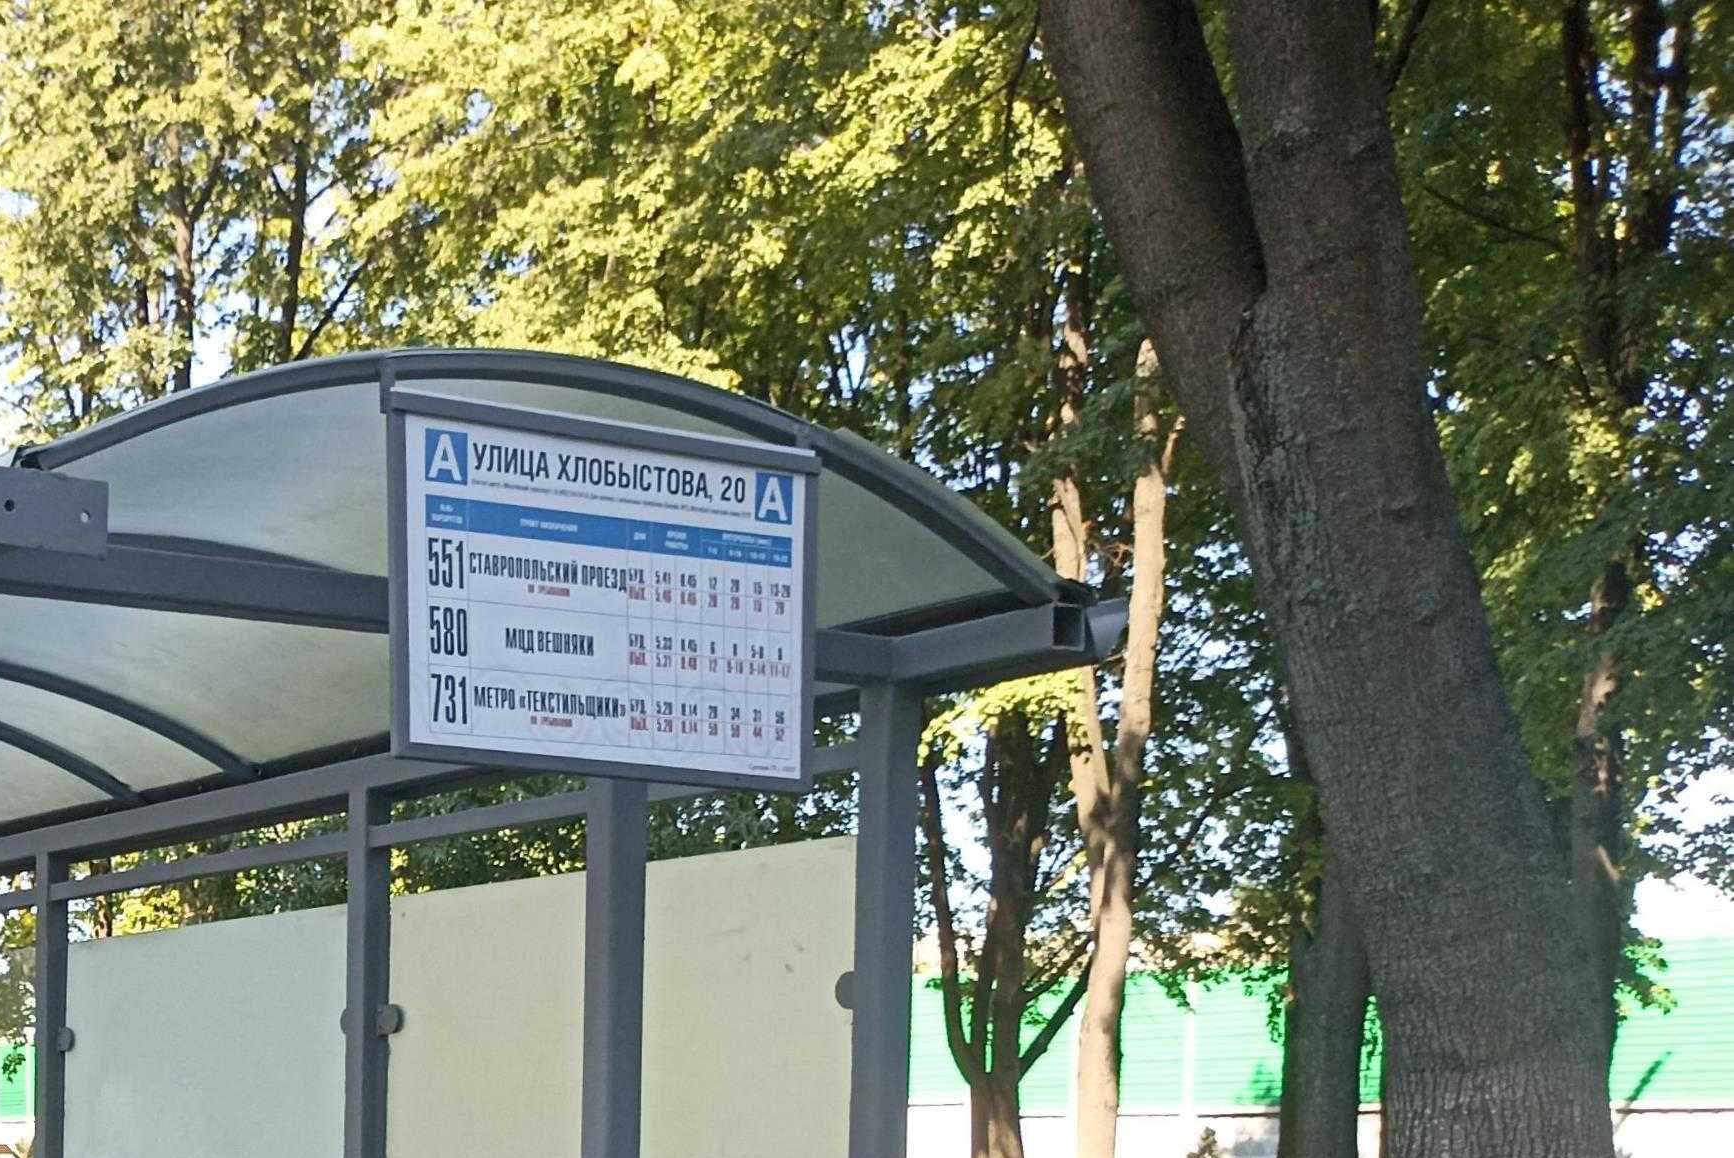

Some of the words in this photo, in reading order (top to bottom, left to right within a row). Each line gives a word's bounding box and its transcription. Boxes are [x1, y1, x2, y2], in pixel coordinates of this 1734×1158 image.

[428, 434, 462, 480] А
[473, 442, 549, 482] УЛИЦА
[557, 453, 713, 503] ХЛОБЫСТОВА,
[721, 476, 746, 503] 20
[758, 477, 788, 521] А
[428, 537, 465, 589] 551
[469, 552, 578, 585] СТАВРОПОЛЬСКИЙ
[582, 565, 627, 593] ПРОЕЗД
[429, 606, 468, 657] 580
[505, 628, 535, 653] МЦД
[537, 631, 594, 656] ВЕШНЯКИ
[430, 673, 467, 725] 731
[474, 686, 515, 710] МЕТРО
[519, 690, 626, 719] «ТЕКСТИЛЬЩИКИ»
